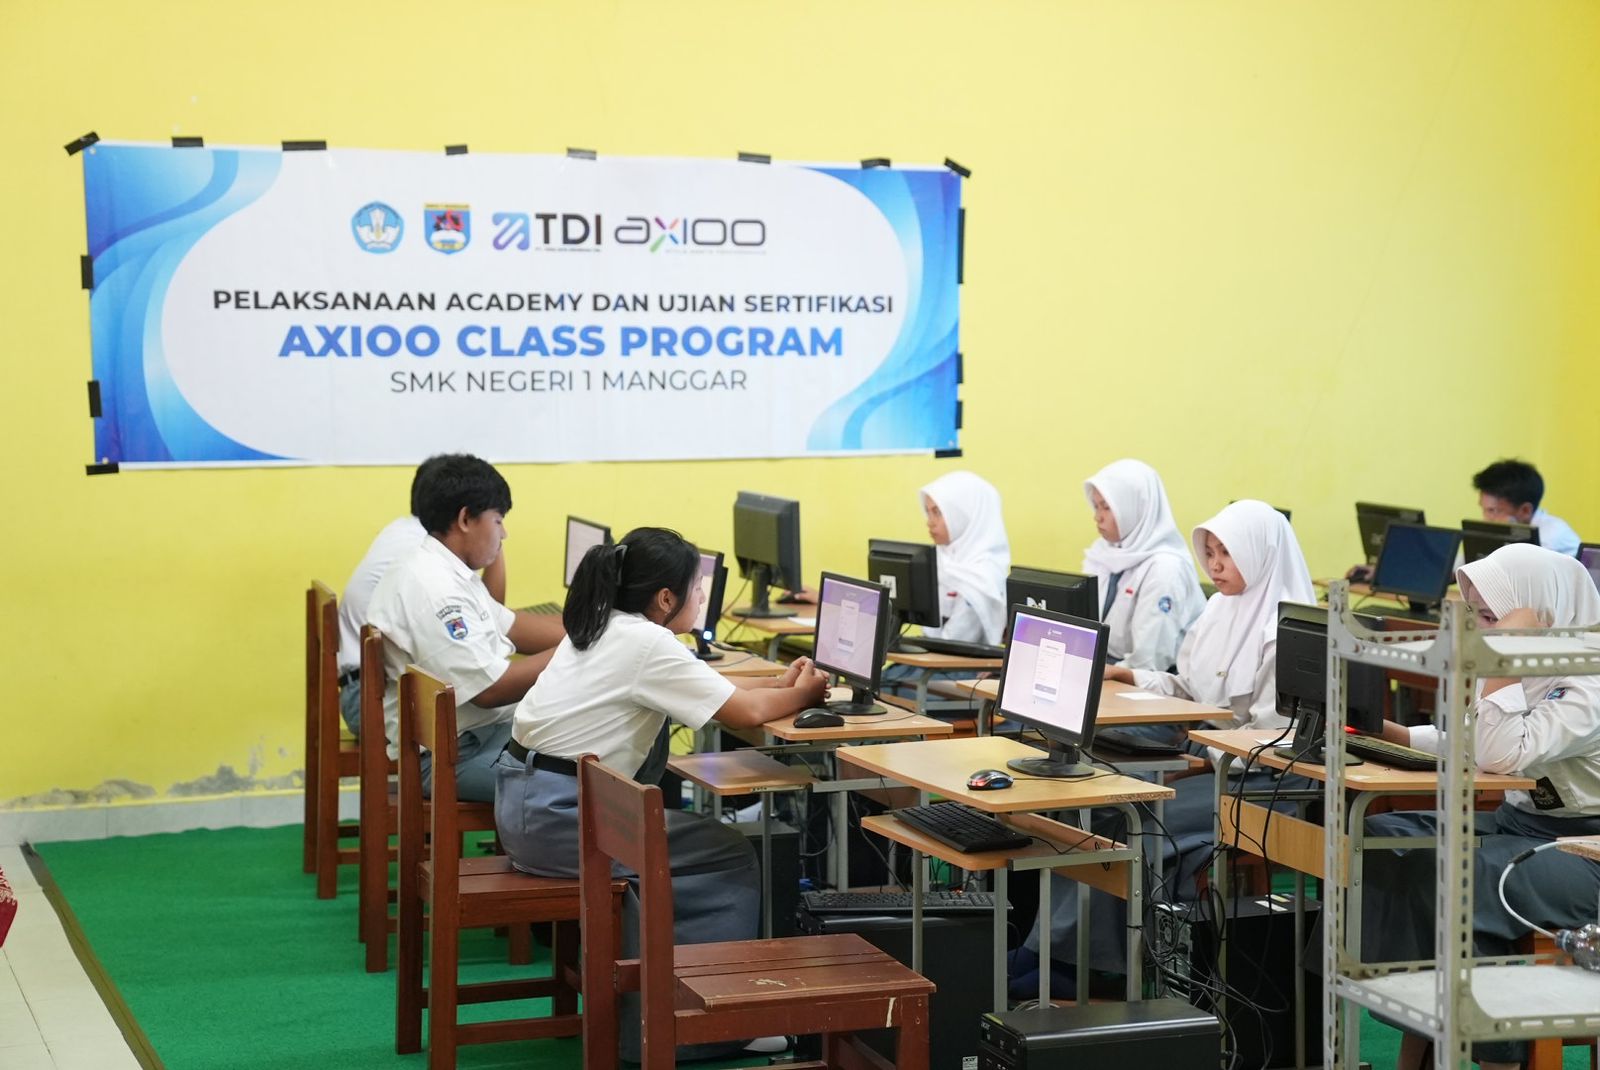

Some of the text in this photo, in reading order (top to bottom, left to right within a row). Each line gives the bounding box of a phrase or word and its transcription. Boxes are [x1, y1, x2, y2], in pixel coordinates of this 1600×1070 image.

[535, 213, 602, 245] TDI
[213, 289, 893, 313] PELAKSANAAN ACADEMY DAN UJIAN SERTIFIKASI
[277, 324, 843, 358] AXIOO CLASS PROGRAM
[391, 369, 747, 393] SMK NEGERI 1 MANGGAR
